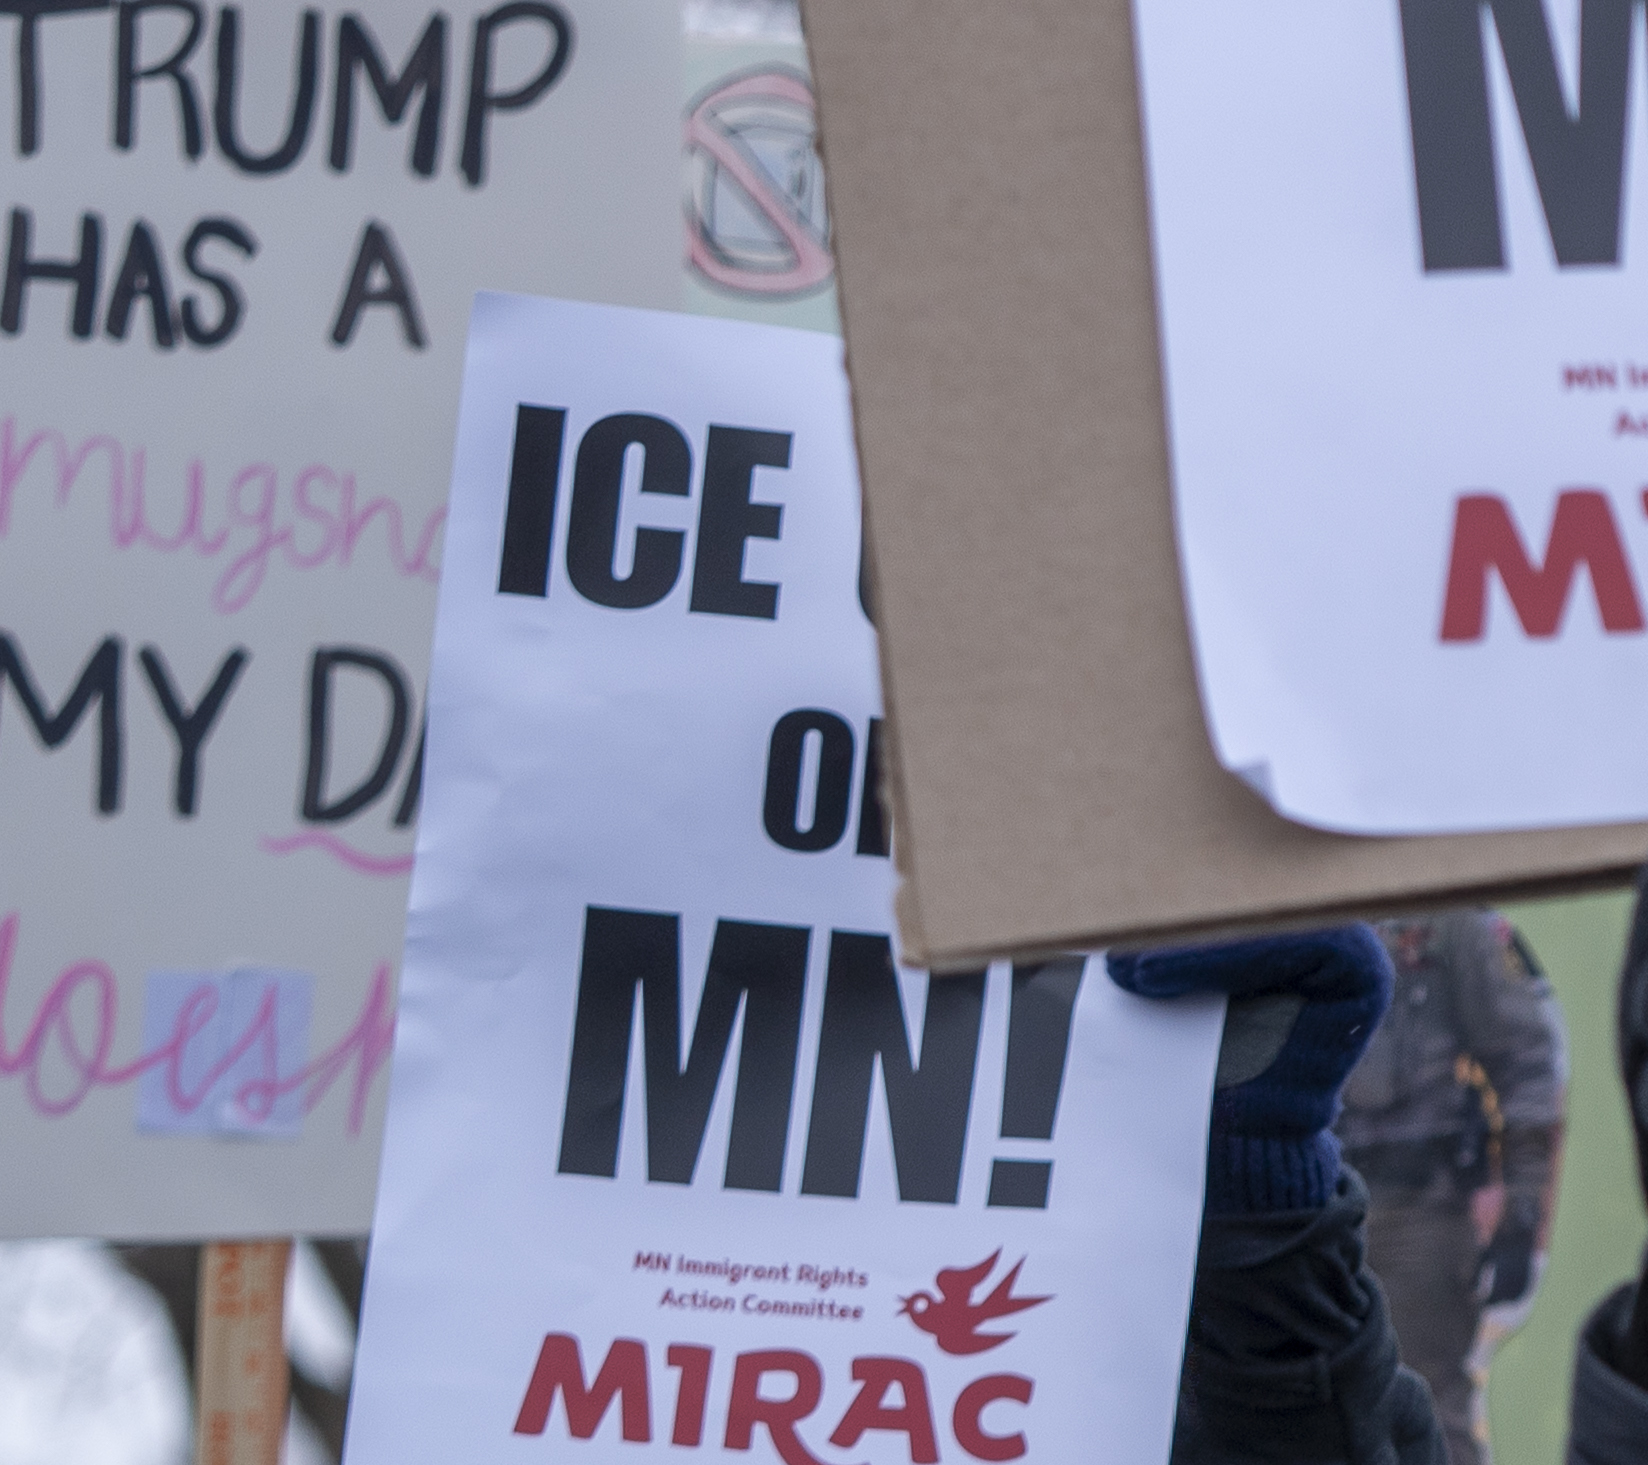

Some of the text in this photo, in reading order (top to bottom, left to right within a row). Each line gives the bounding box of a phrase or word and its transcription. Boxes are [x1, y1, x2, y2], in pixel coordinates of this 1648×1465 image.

[0, 208, 427, 350] HAS A
[1562, 361, 1620, 393] MN
[498, 402, 796, 621] ICE
[0, 632, 252, 823] MY
[0, 914, 400, 1138] oes
[555, 904, 1090, 1210] MN!
[633, 1250, 870, 1291] MN Immigrant Rights
[660, 1287, 865, 1321] Action Committee
